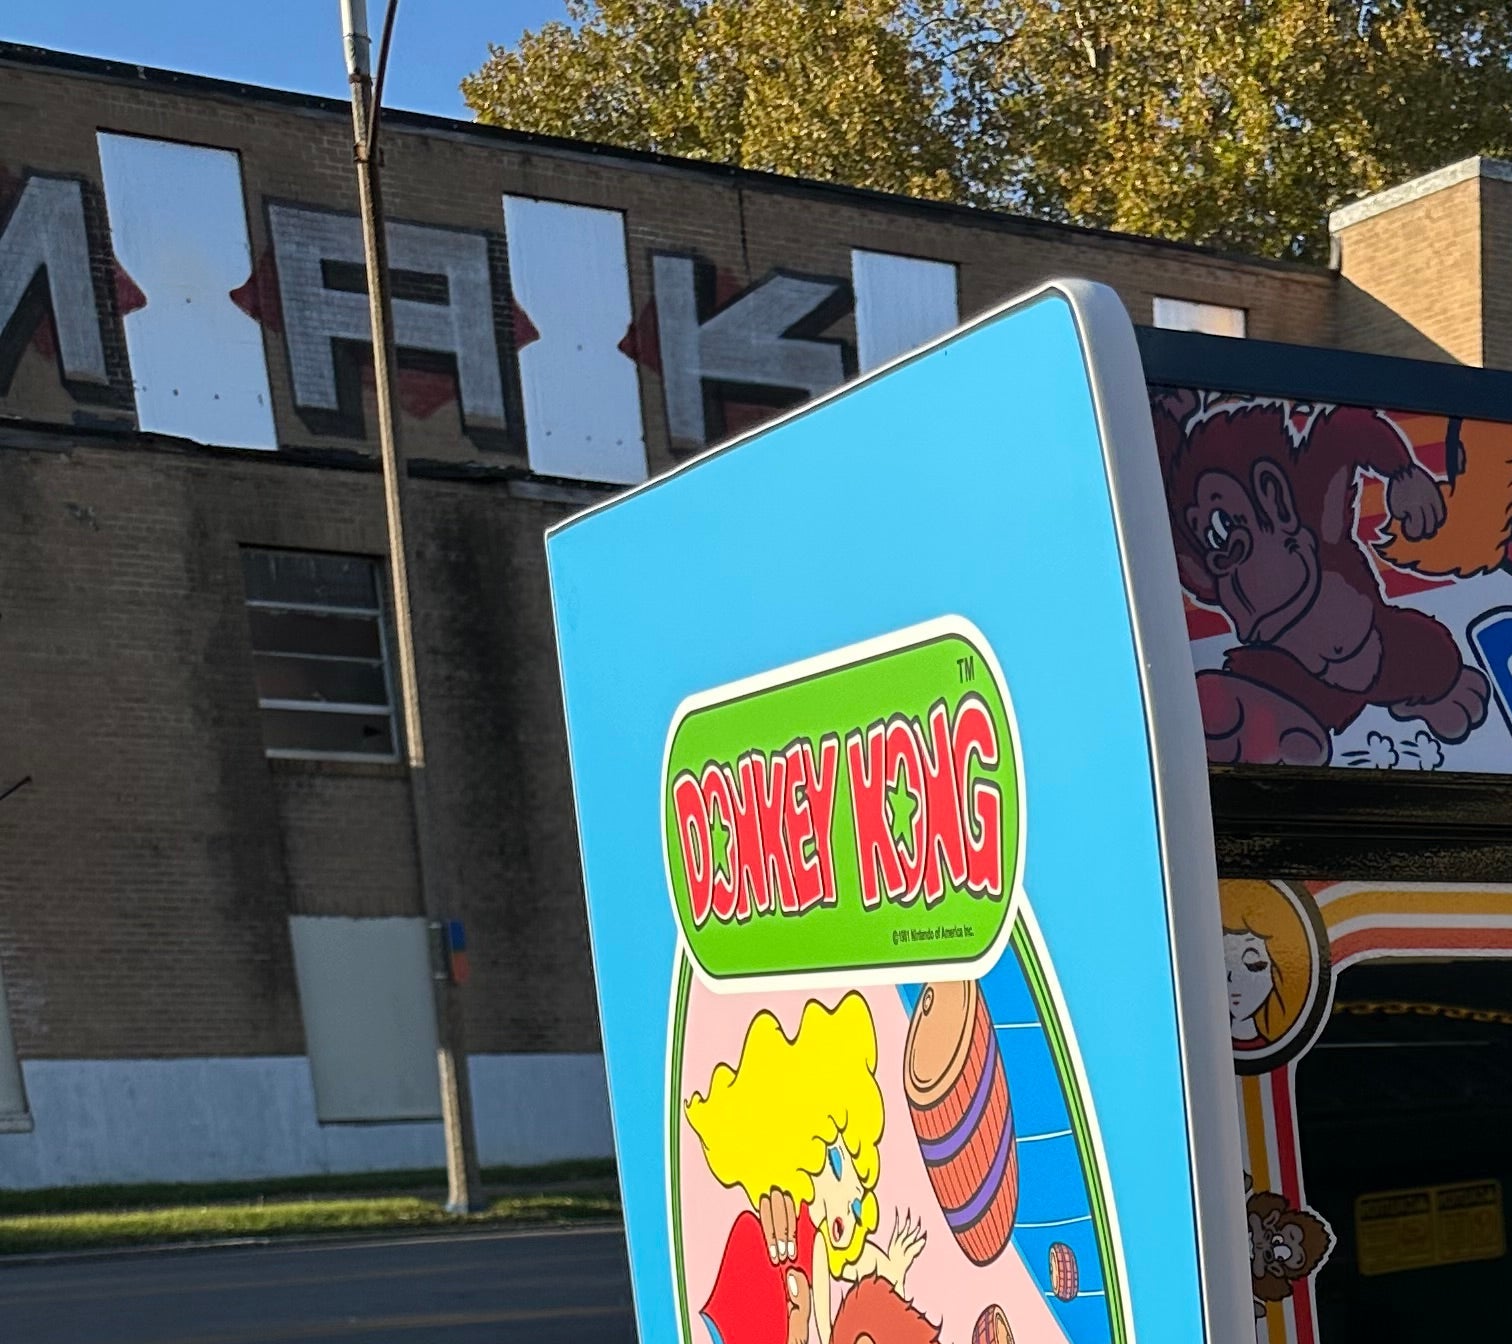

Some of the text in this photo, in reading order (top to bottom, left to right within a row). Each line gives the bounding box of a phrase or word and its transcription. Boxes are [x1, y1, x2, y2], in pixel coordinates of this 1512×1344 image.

[957, 655, 976, 684] TM
[672, 691, 1004, 931] DONKEY KONG
